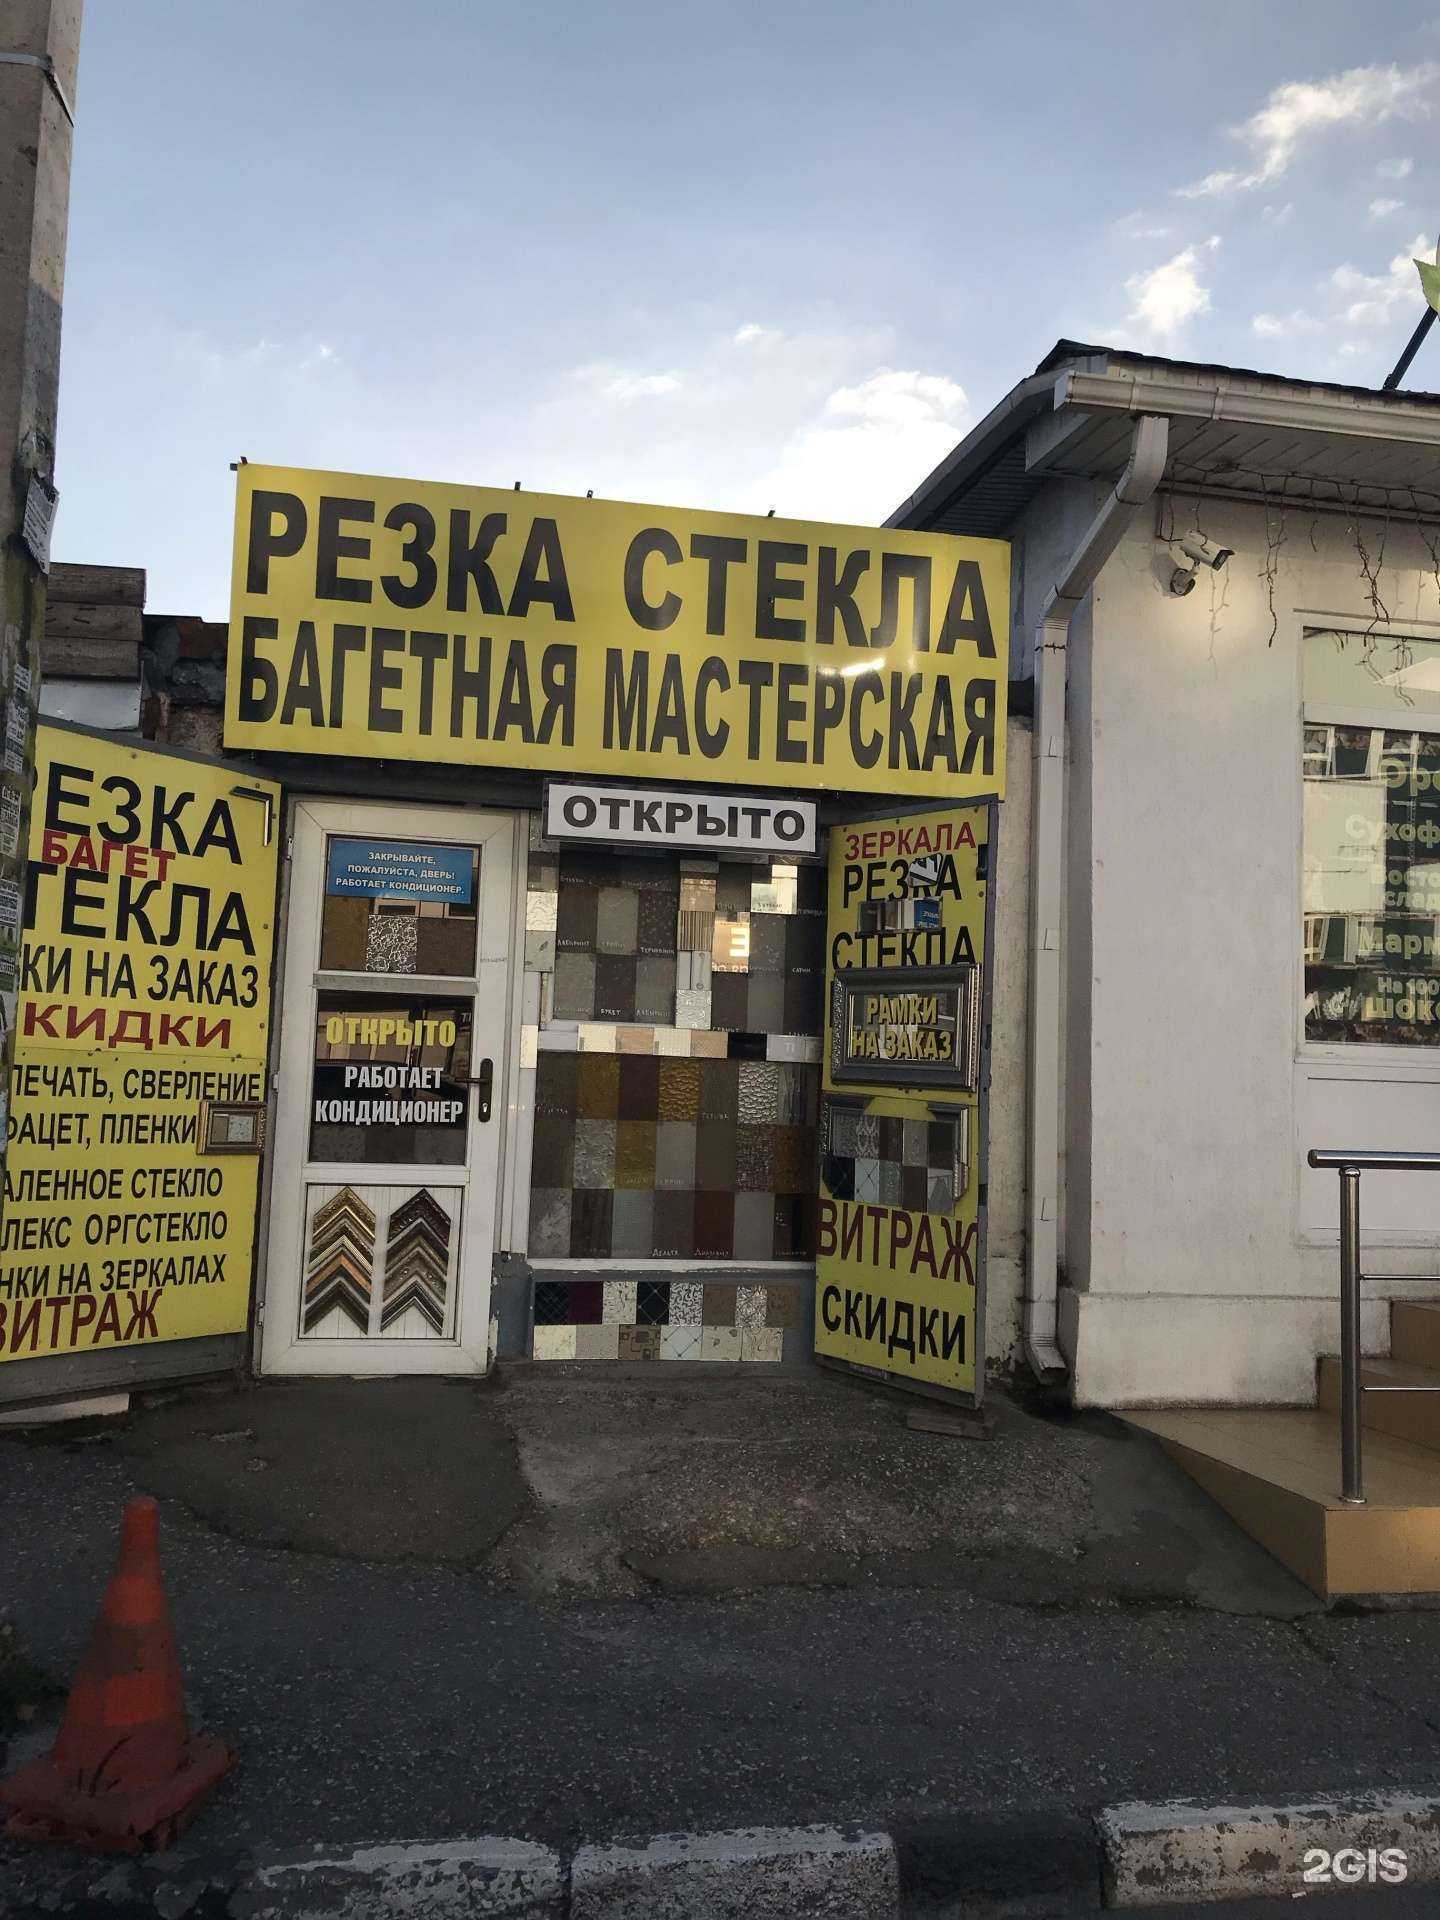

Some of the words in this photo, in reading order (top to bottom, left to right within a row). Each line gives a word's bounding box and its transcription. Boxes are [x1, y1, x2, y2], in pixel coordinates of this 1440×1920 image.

[246, 490, 576, 622] РЕЗКА
[623, 528, 997, 659] СТЕКЛА
[237, 616, 578, 747] БАГЕТНАЯ
[601, 647, 998, 776] МАСТЕРСКАЯ
[33, 761, 243, 865] ЕЗКА
[563, 795, 805, 842] ОТКРЫТО
[42, 829, 177, 882] БАГЕТ
[368, 852, 436, 865] ЗАКРЫВАЙТЕ,
[845, 822, 976, 861] ЗЕРКАЛА
[336, 878, 386, 889] РАБОТАЕТ
[389, 881, 465, 894] КОНДИЦИОНЕР.
[347, 864, 418, 878] ПОЖАЛУЙСТА,
[420, 870, 455, 880] ДВЕРЬ!
[832, 926, 976, 972] СТЕКЛА
[85, 950, 137, 999] НА
[147, 955, 259, 1008] ЗАКАЗ
[867, 996, 938, 1026] РАМКИ
[326, 1017, 456, 1047] ОТКРЫТО
[852, 1029, 880, 1059] НА
[886, 1030, 953, 1061] ЗАКАЗ
[123, 1069, 261, 1101] СВЕРЛЕНИЕ
[344, 1066, 444, 1089] РАБОТАЕТ
[100, 1114, 197, 1144] ПЛЕНКИ
[315, 1100, 463, 1126] КОНДИЦИОНЕР
[131, 1168, 223, 1199] СТЕКЛО
[85, 1211, 228, 1245] ОРГСТЕКЛО
[815, 1199, 978, 1286] ВИТРАЖ
[57, 1263, 92, 1295] НА
[100, 1254, 227, 1292] ЗЕРКАЛАХ
[822, 1285, 966, 1364] СКИДКИ
